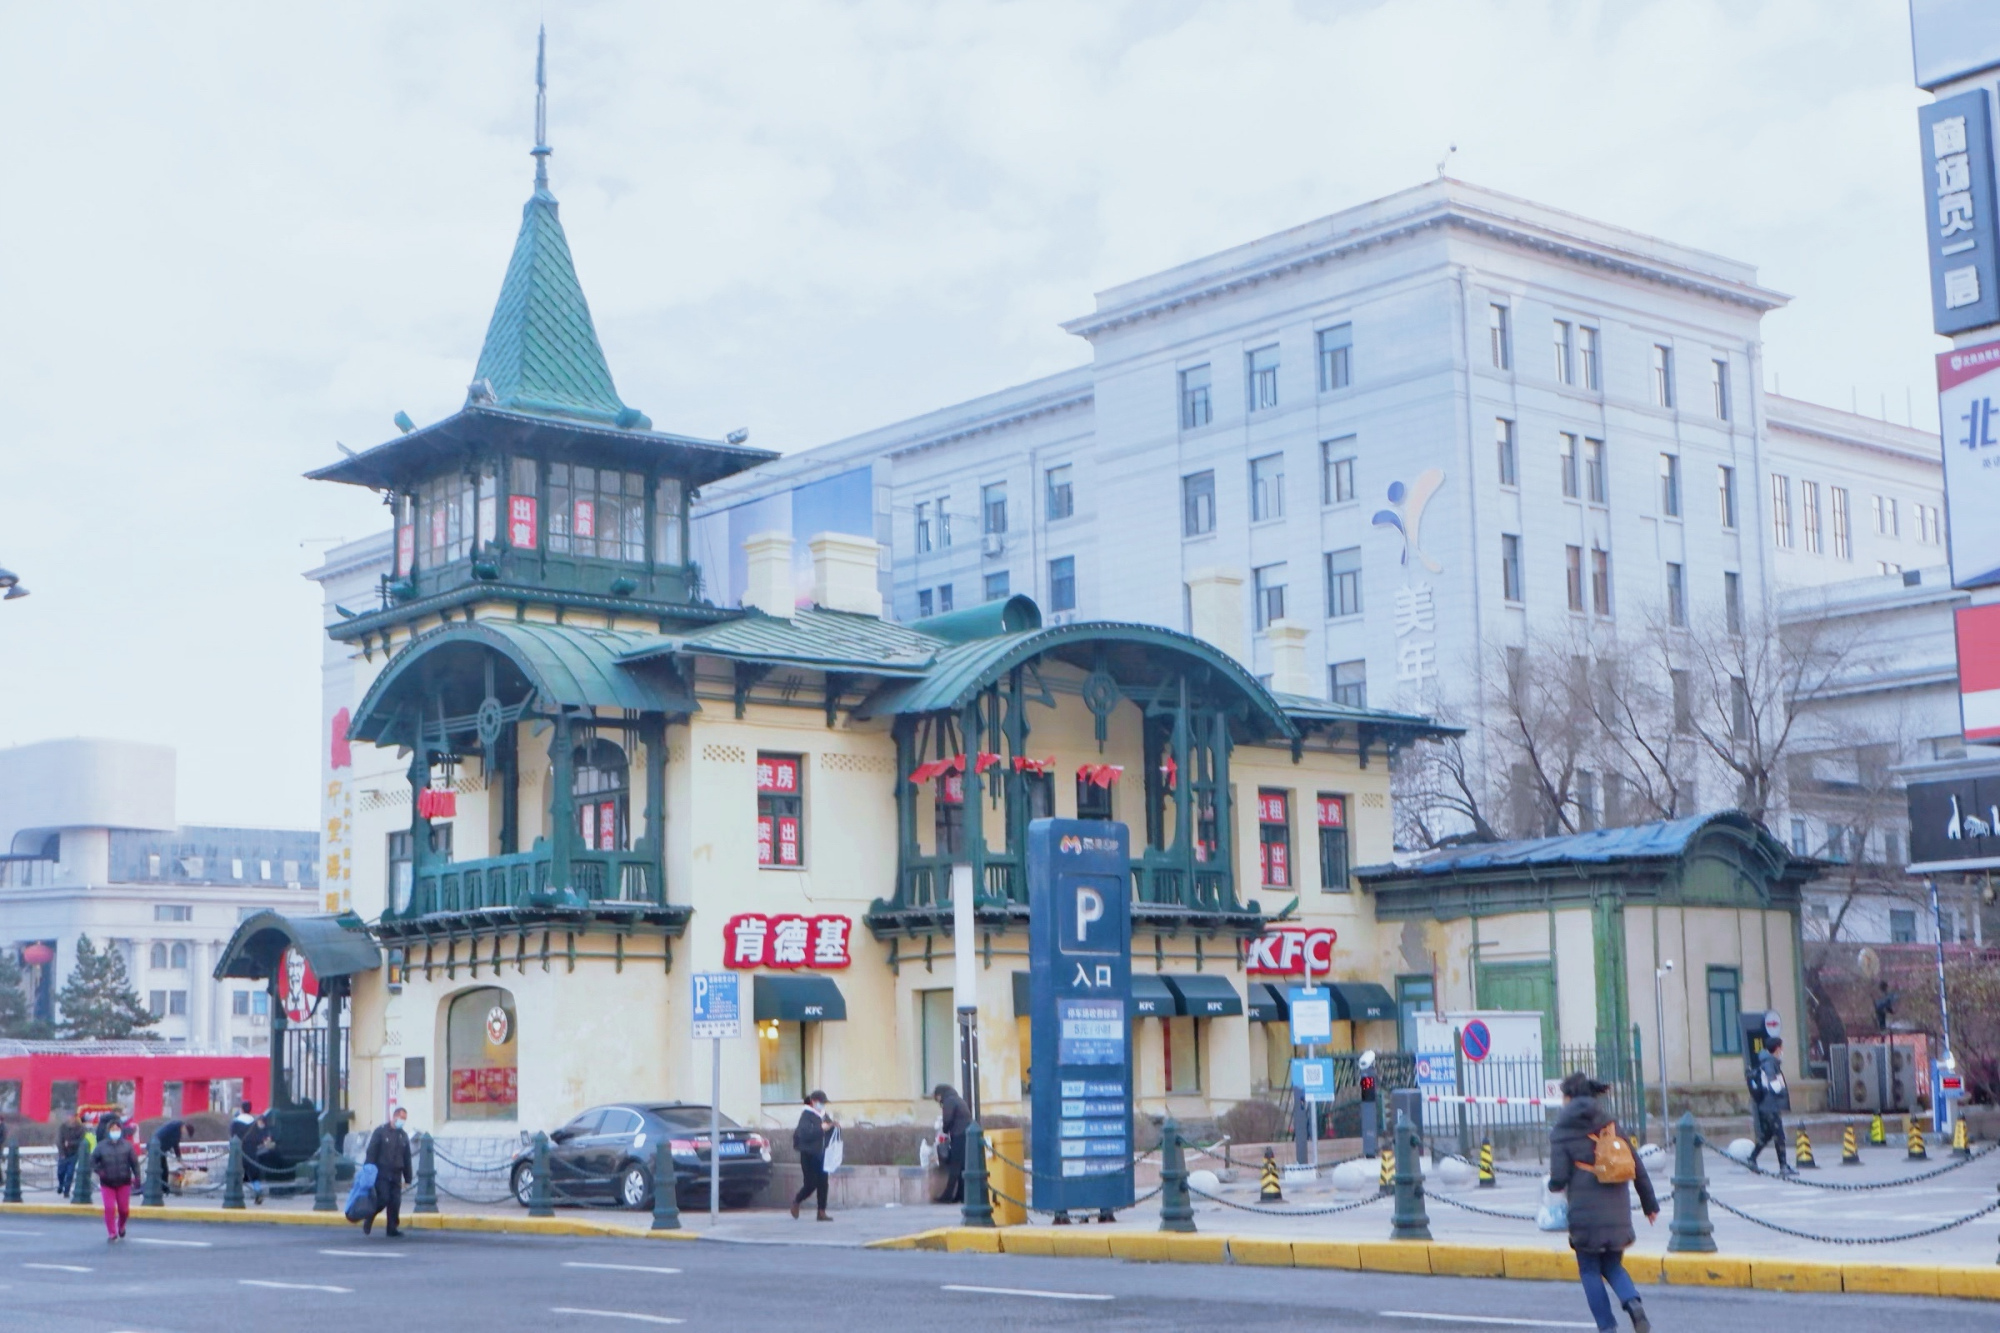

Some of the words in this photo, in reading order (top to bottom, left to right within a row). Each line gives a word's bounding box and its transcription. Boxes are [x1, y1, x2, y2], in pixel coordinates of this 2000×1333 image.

[757, 764, 794, 789] 卖房
[781, 821, 797, 861] 出租
[1076, 887, 1104, 942] P
[734, 917, 848, 963] 肯德基
[1247, 931, 1331, 970] KFC
[1072, 962, 1112, 988] 入口
[694, 976, 708, 1014] P
[1138, 1001, 1155, 1011] KFC
[1207, 1001, 1223, 1011] KFC
[804, 1005, 823, 1016] KFC
[1367, 1007, 1381, 1016] KFC
